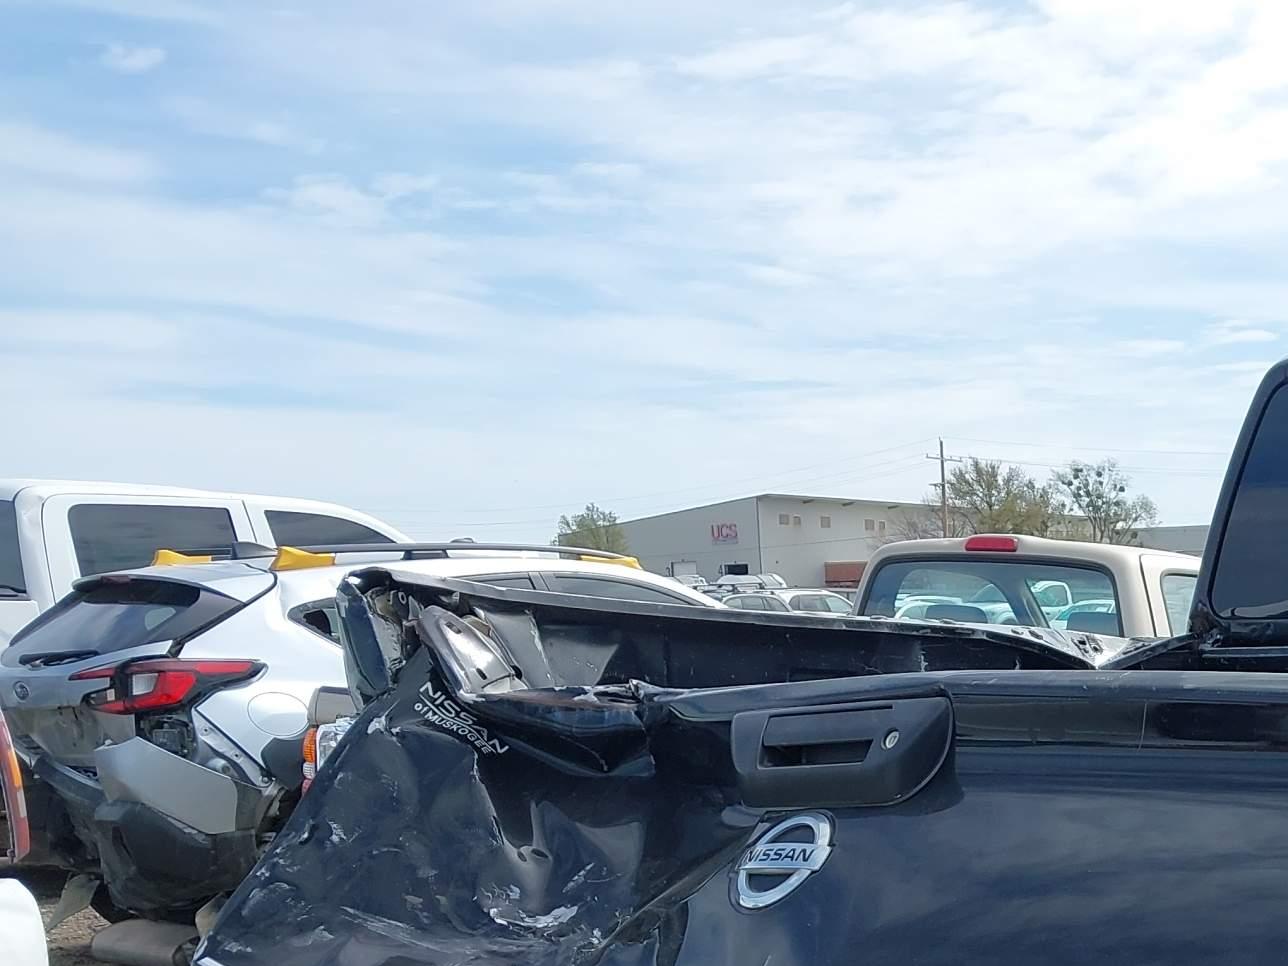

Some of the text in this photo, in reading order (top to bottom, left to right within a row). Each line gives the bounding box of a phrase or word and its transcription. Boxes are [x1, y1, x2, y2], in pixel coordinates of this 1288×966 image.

[711, 523, 738, 539] UCS
[414, 702, 492, 754] of MUSKOGEE
[419, 681, 509, 753] NISSAN
[744, 848, 815, 862] NISSAN
